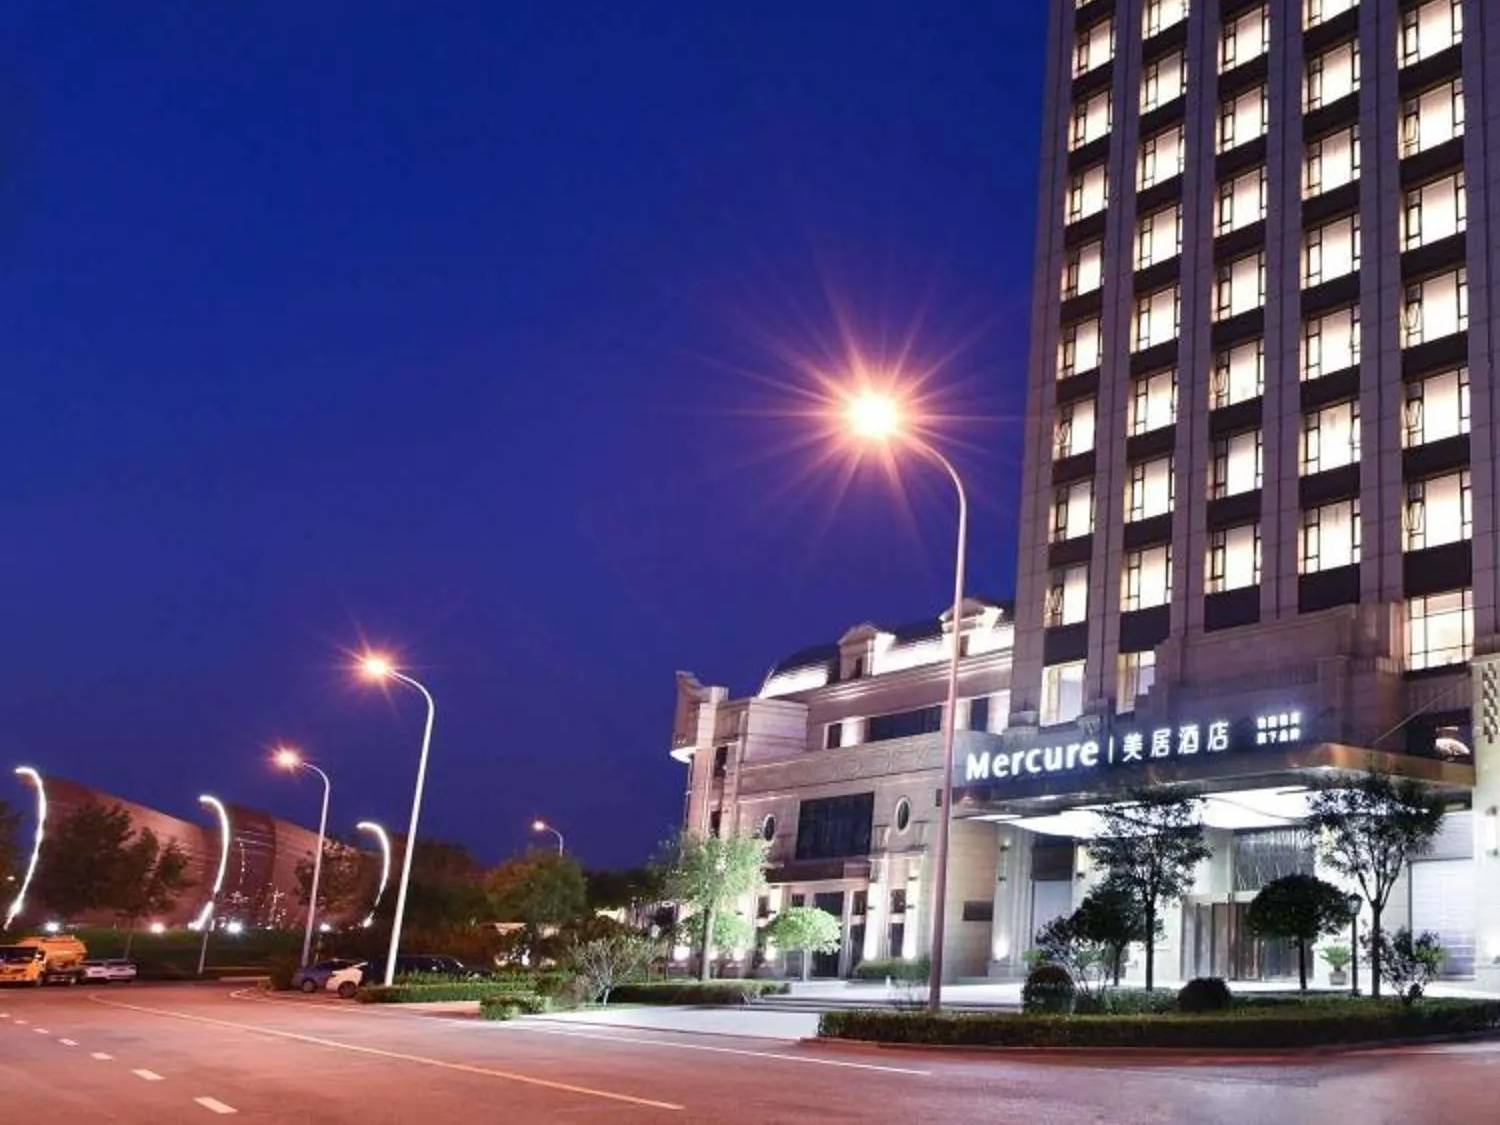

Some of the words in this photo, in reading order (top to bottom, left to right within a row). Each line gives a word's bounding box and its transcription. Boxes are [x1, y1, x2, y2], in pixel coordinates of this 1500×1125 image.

[965, 739, 1099, 781] Mercure
[1122, 721, 1230, 762] 美居酒店
